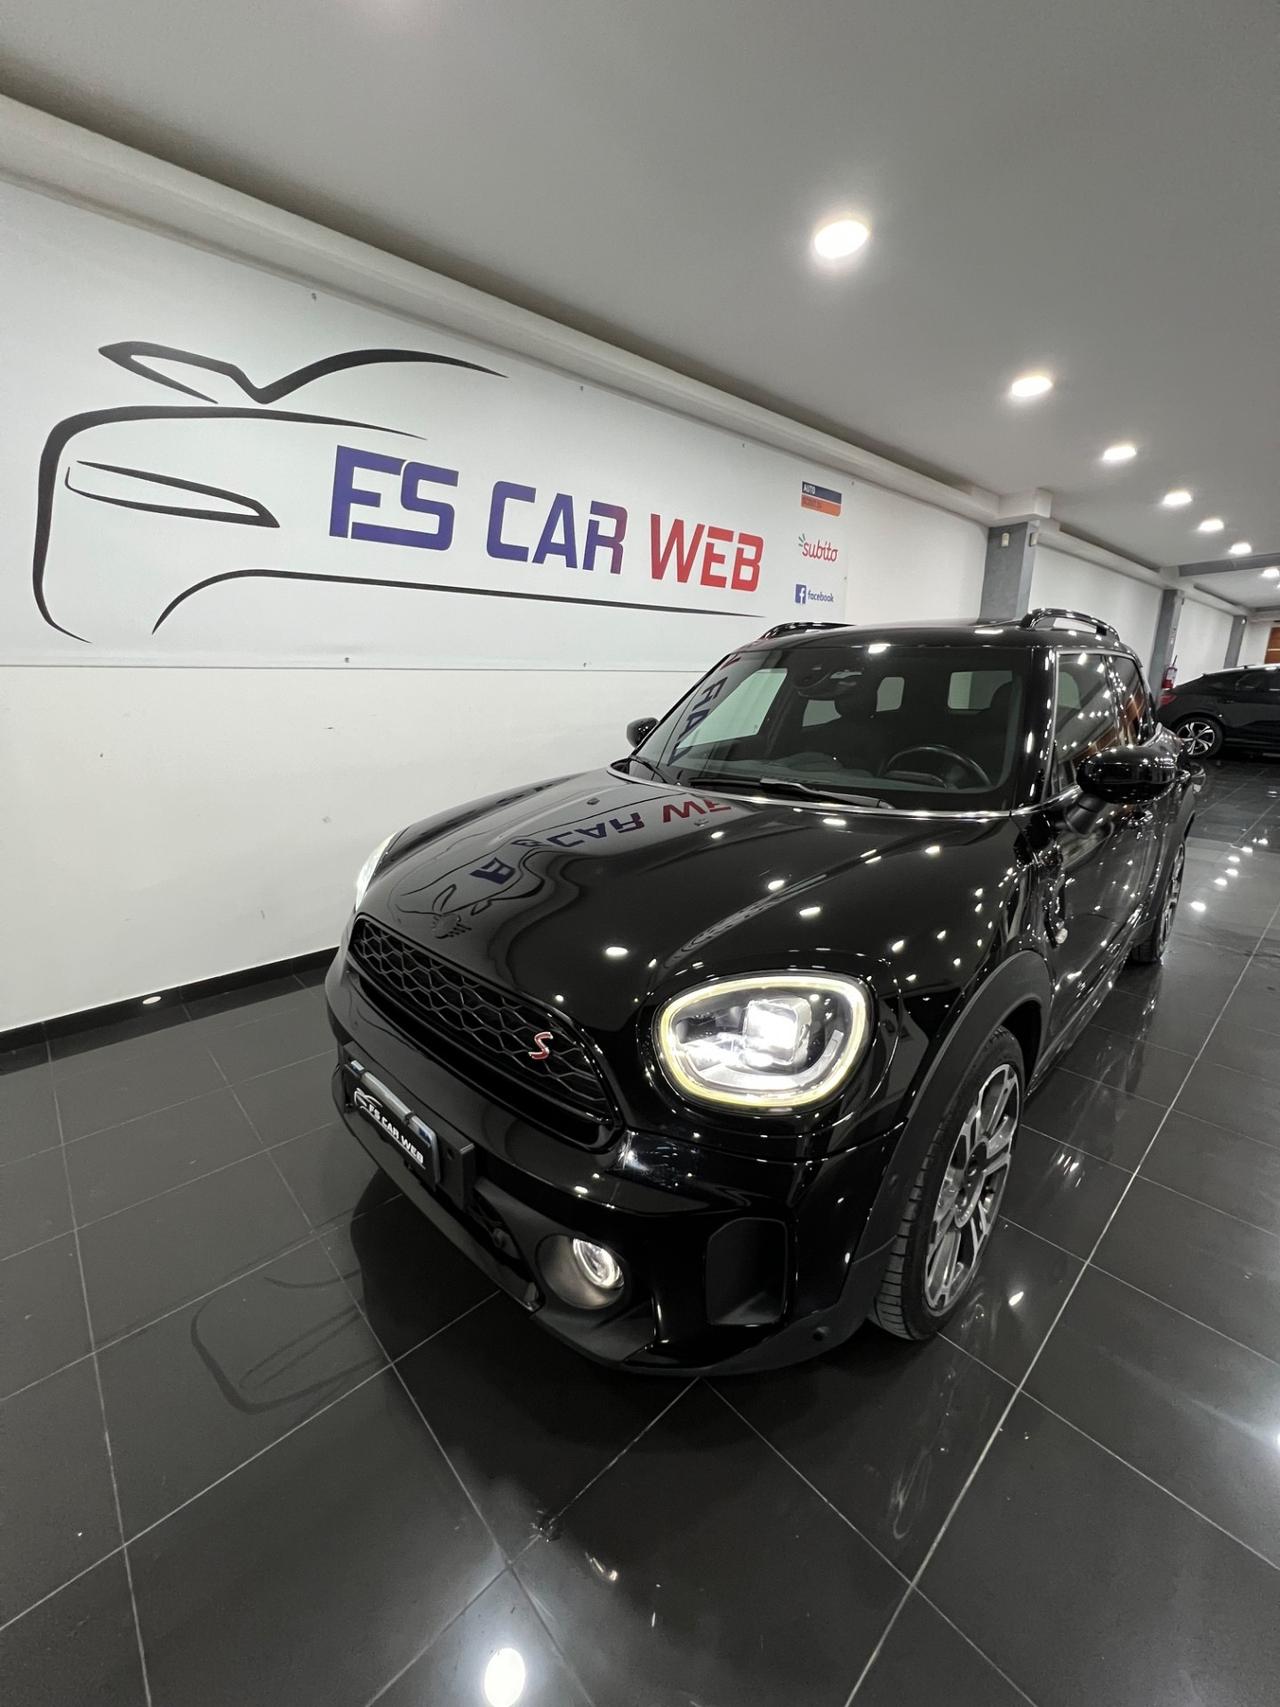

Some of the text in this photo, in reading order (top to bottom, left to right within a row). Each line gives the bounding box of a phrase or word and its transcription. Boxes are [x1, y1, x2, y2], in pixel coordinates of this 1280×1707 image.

[329, 445, 764, 592] ES CAR WEB
[802, 538, 839, 562] subito
[808, 589, 834, 603] facebook
[528, 1032, 553, 1060] S
[382, 1116, 399, 1140] CAR
